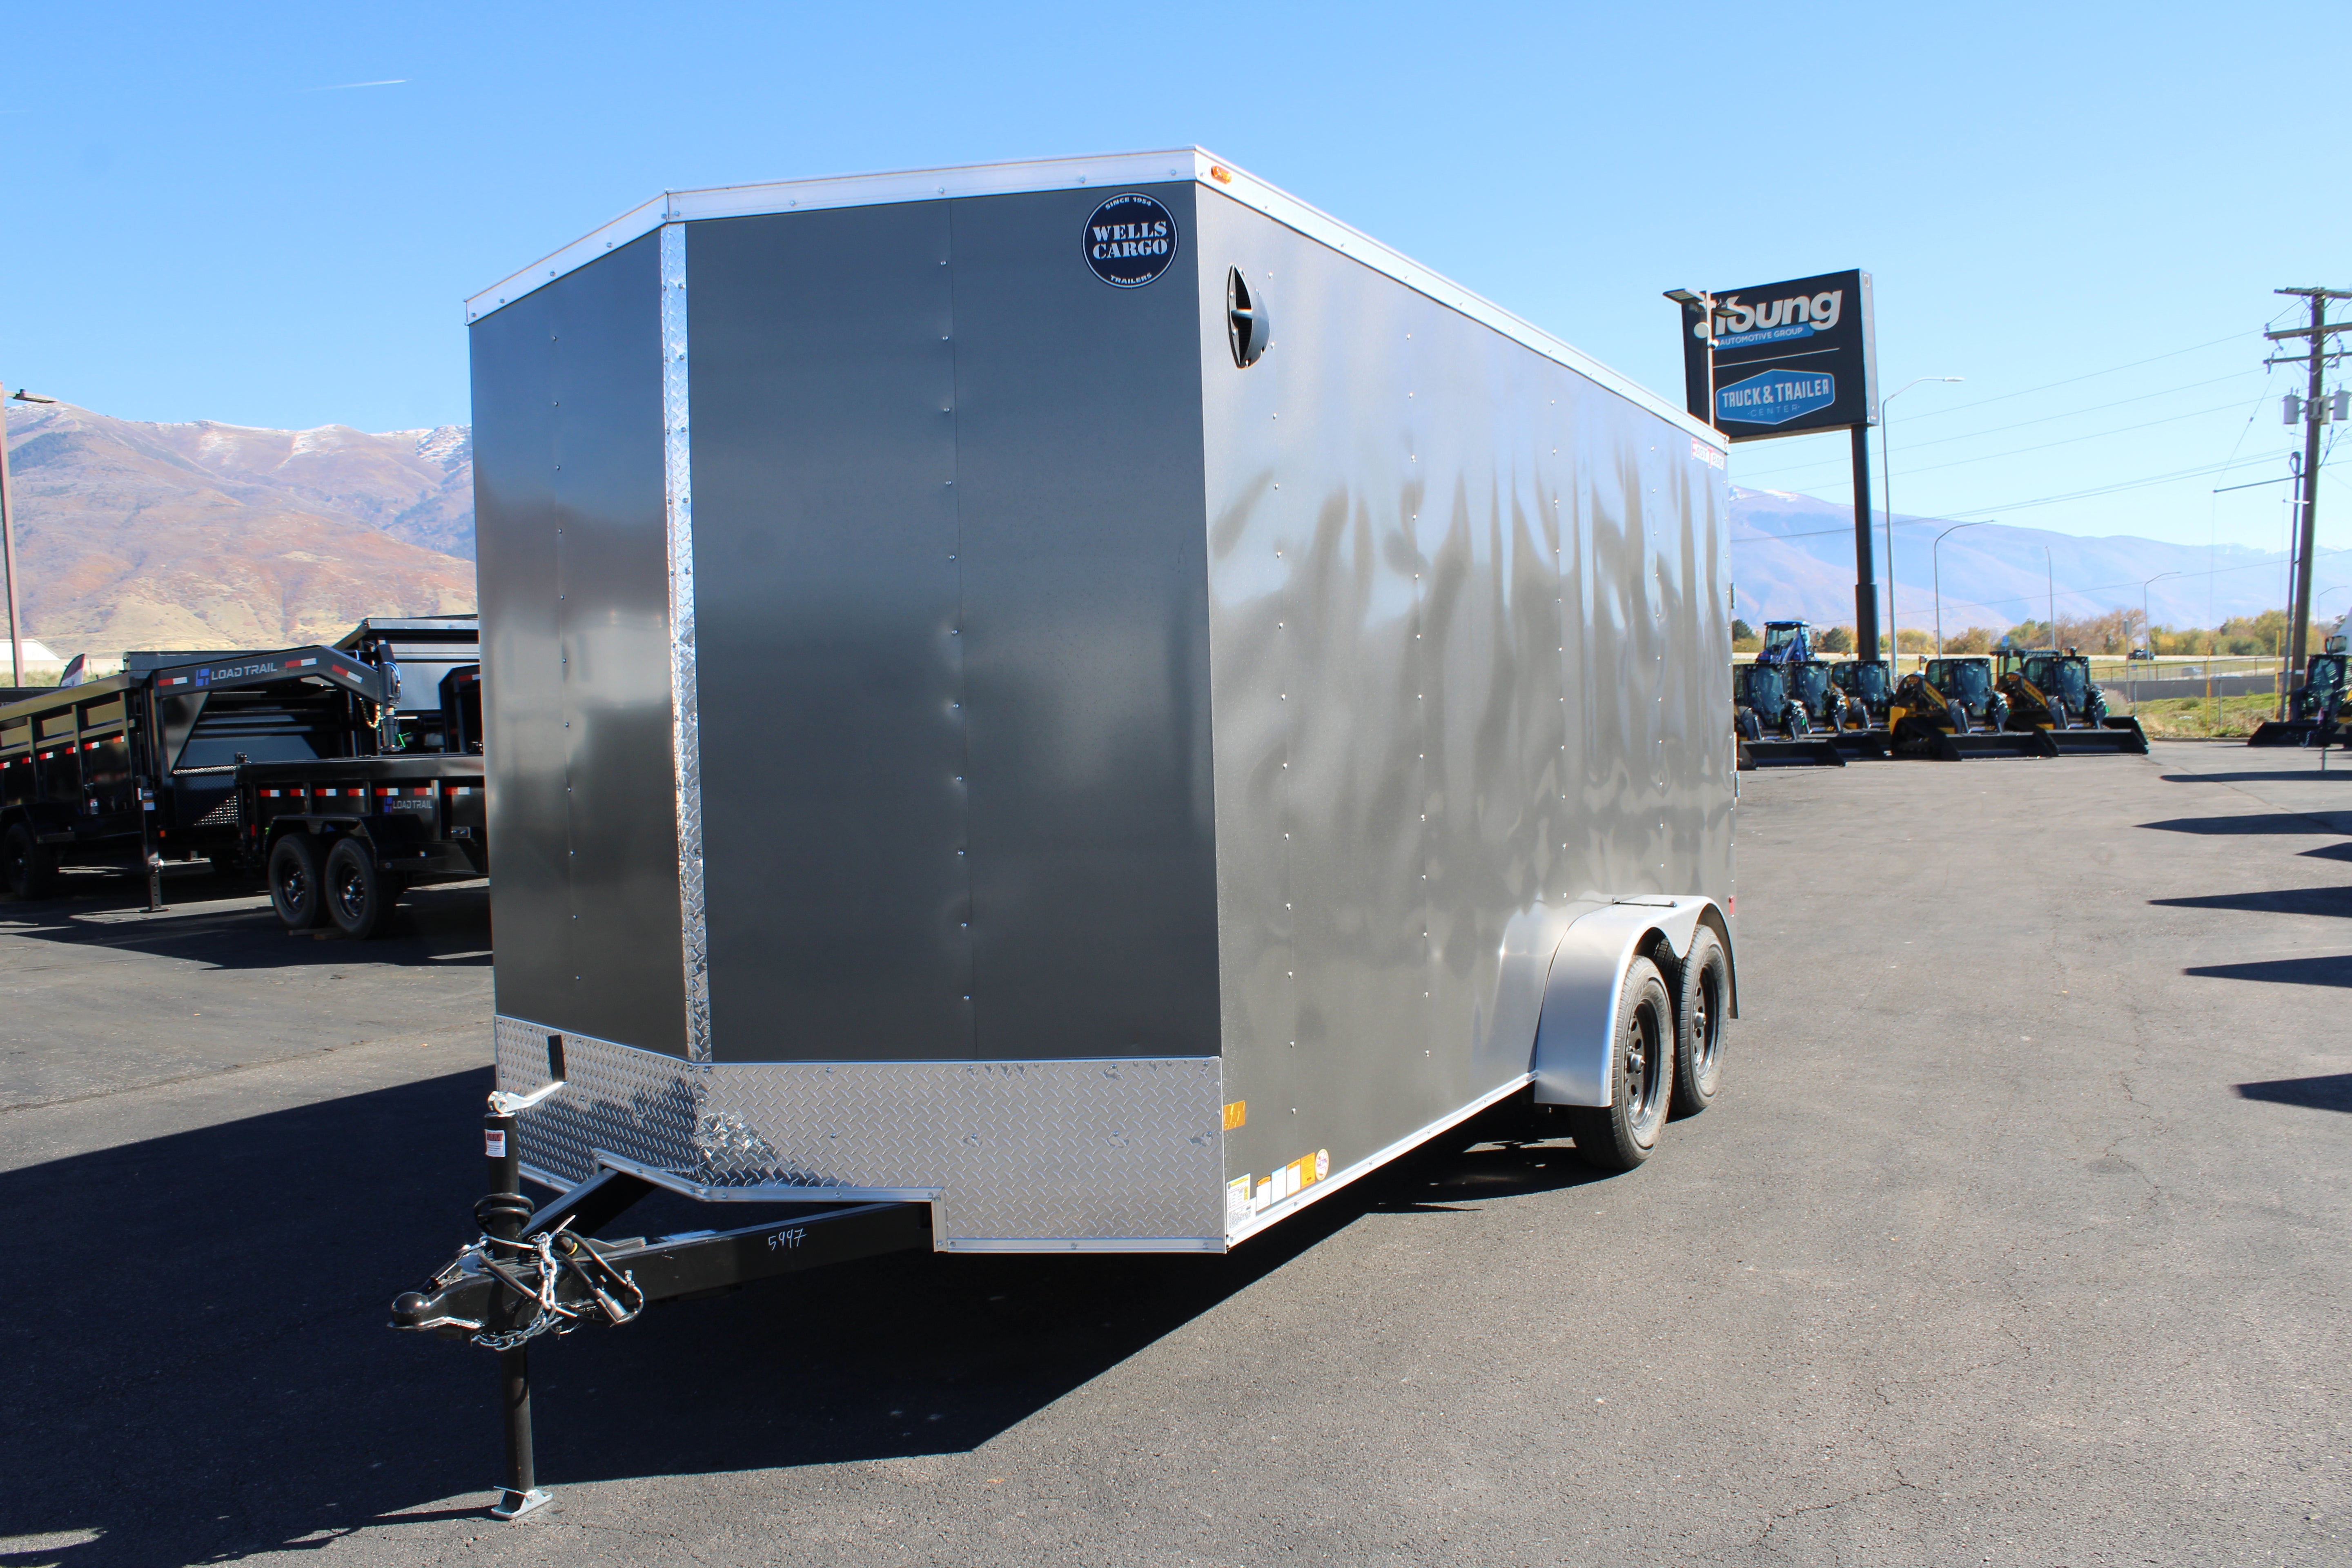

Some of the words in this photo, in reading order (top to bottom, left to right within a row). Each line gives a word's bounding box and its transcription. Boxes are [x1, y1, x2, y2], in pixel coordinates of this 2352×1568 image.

[1105, 197, 1130, 210] SINCE
[1092, 221, 1167, 242] WELLS
[1093, 239, 1168, 259] CARGO
[1110, 272, 1152, 284] TRAILERS
[1719, 331, 1773, 346] AUTOMOTIVE
[1773, 327, 1803, 338] GROUP
[1722, 387, 1762, 408] TRUCK
[1762, 385, 1774, 404] &
[1775, 378, 1830, 403] TRAILER
[1750, 404, 1798, 417] CENTER
[211, 667, 243, 680] LOAD
[244, 663, 278, 675] TRAIL
[393, 800, 412, 808] LOAD
[412, 800, 433, 808] TRAIL
